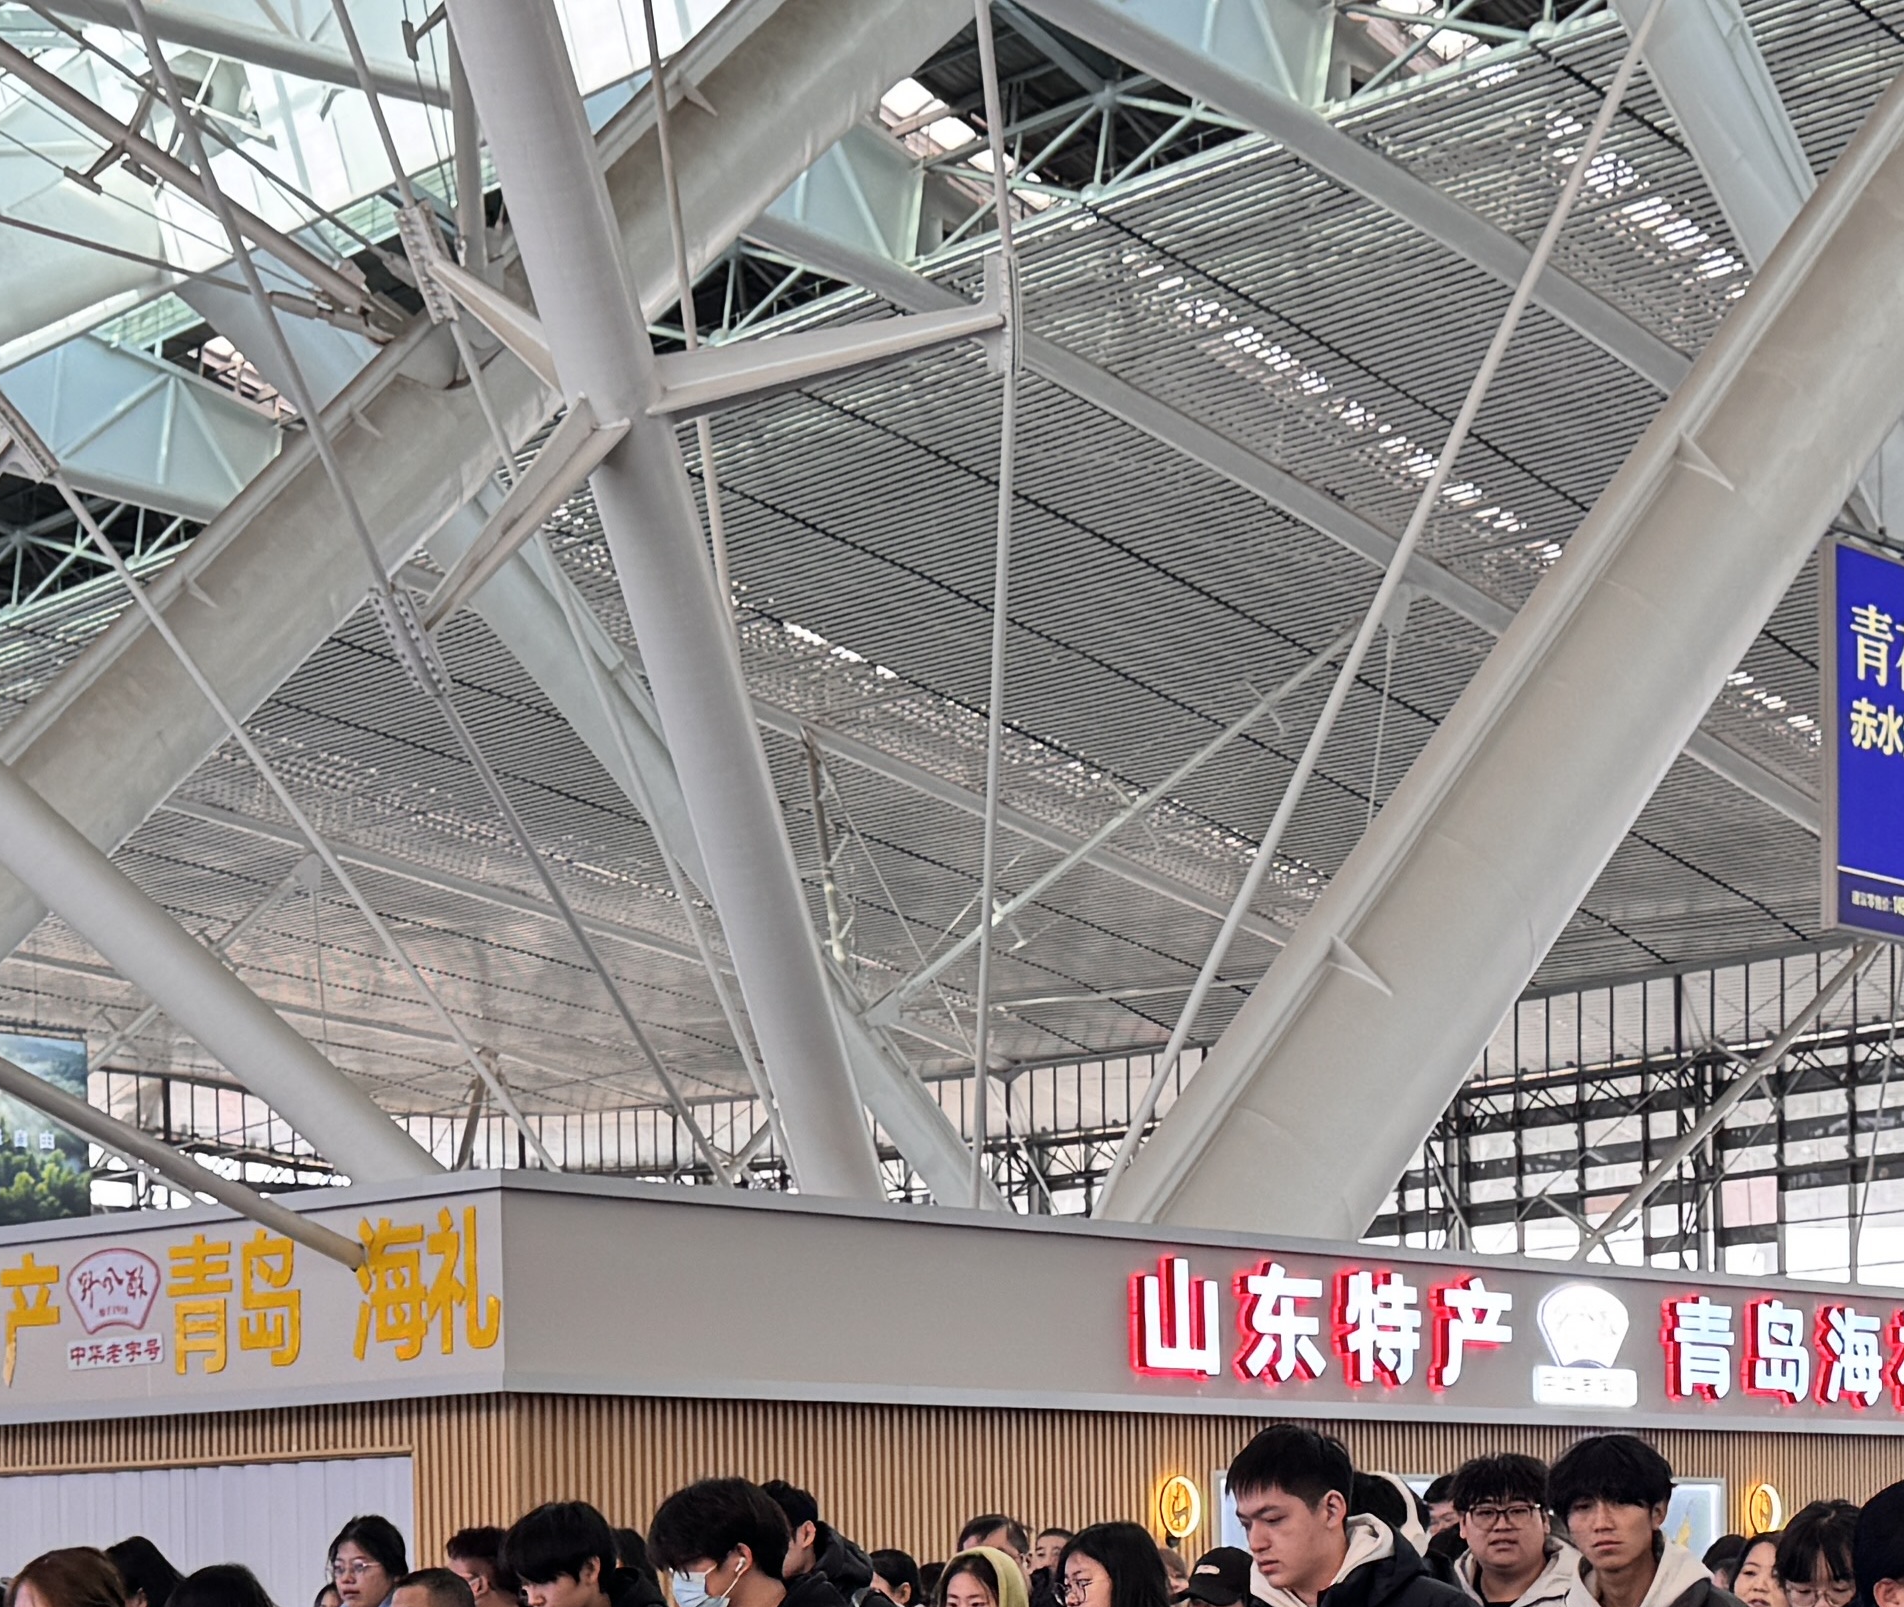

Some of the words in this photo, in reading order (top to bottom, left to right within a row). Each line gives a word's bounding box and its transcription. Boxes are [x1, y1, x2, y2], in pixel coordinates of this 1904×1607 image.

[167, 1229, 301, 1375] 青岛
[353, 1205, 500, 1361] 海礼
[1134, 1257, 1513, 1389] 山东特产
